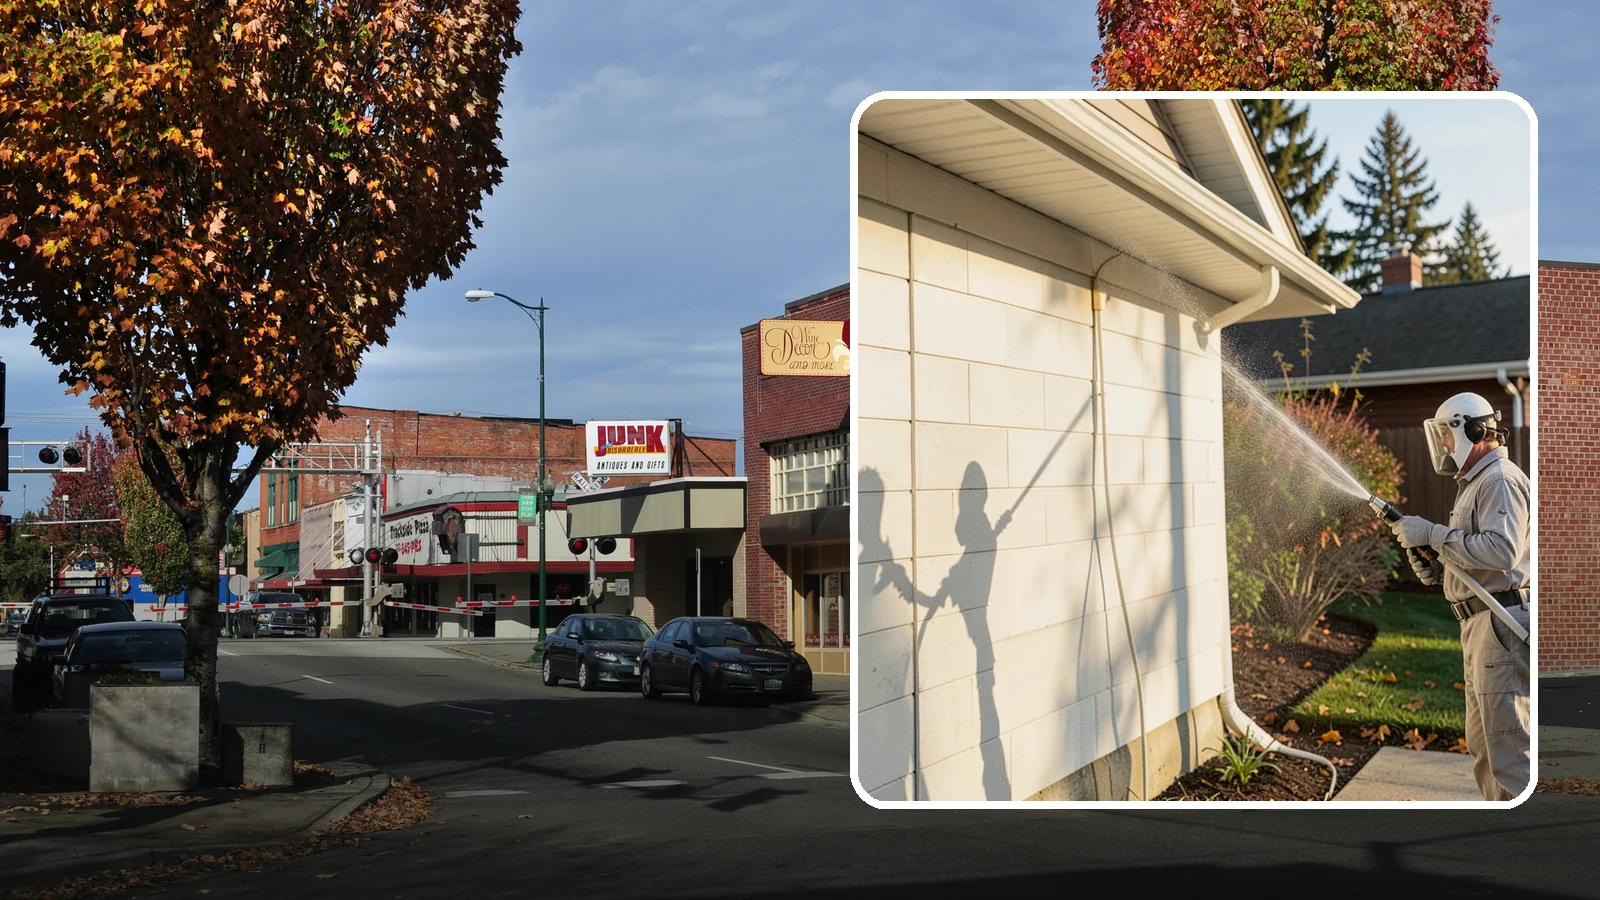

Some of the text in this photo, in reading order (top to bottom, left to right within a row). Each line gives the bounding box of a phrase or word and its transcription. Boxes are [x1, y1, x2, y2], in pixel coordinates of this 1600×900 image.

[595, 425, 666, 457] JUNK
[607, 446, 646, 454] DISORDERLY
[596, 460, 665, 470] ANTIQUES AND GIFTS
[414, 519, 429, 535] Pizza
